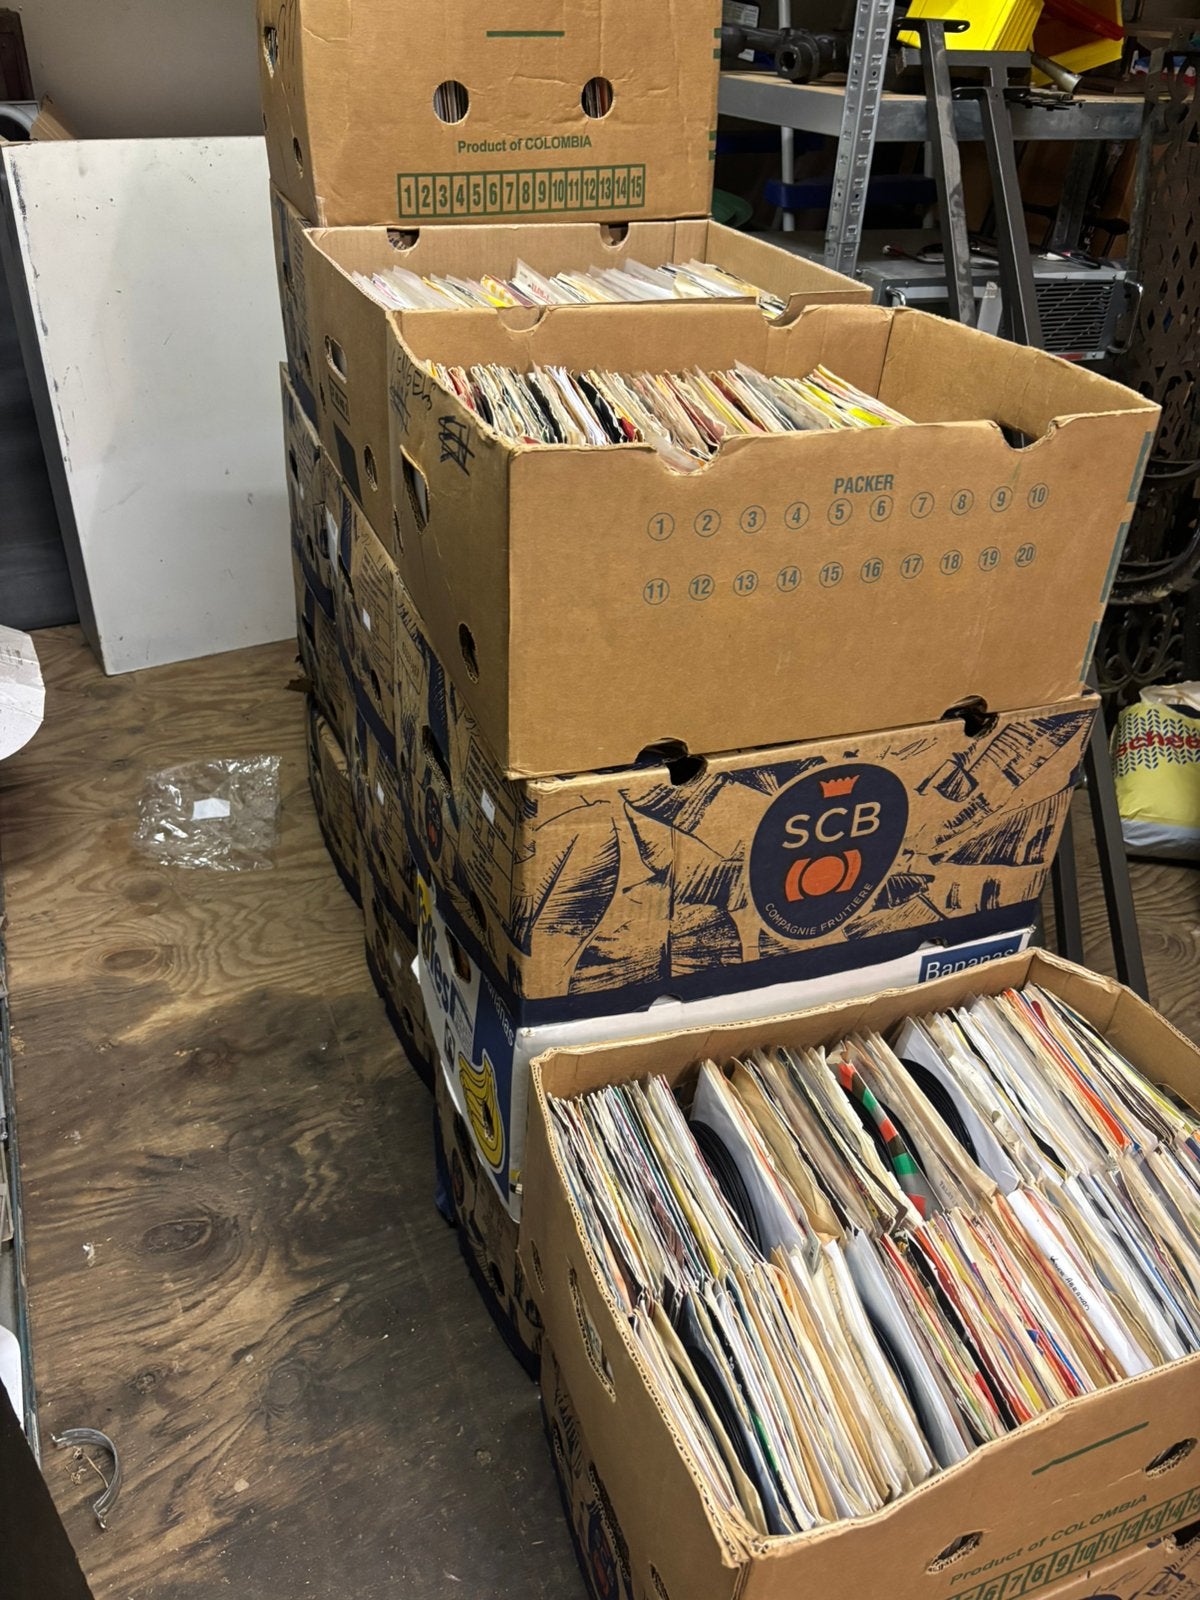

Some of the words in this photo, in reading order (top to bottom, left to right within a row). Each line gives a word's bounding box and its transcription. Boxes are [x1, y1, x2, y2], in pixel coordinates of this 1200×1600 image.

[457, 139, 507, 154] Product
[510, 137, 524, 151] of
[524, 135, 592, 150] COLOMBIA
[404, 184, 412, 208] 1
[421, 184, 430, 208] 2
[438, 184, 448, 208] 3
[456, 184, 464, 207] 4
[472, 183, 481, 207] 5
[488, 182, 498, 206] 6
[505, 181, 514, 205] 7
[522, 180, 530, 204] 8
[538, 180, 546, 203] 9
[552, 178, 564, 203] 10
[568, 178, 580, 202] 11
[584, 177, 596, 201] 12
[600, 176, 612, 200] 13
[615, 175, 626, 199] 14
[631, 174, 642, 198] 15
[833, 473, 895, 495] PACKER
[656, 519, 665, 535] 1
[702, 515, 712, 532] 2
[748, 511, 758, 528] 3
[791, 507, 801, 524] 4
[835, 504, 845, 520] 5
[876, 500, 886, 517] 6
[918, 497, 928, 514] 7
[957, 494, 967, 510] 8
[996, 491, 1006, 508] 9
[1030, 488, 1046, 504] 10
[648, 583, 664, 600] 11
[693, 578, 710, 596] 12
[738, 574, 755, 591] 13
[781, 570, 798, 587] 14
[823, 566, 840, 583] 15
[864, 562, 881, 578] 16
[904, 558, 921, 574] 17
[944, 554, 960, 570] 18
[982, 550, 998, 566] 19
[1018, 548, 1034, 563] 20
[782, 801, 881, 849] SCB
[764, 902, 817, 936] COMPAGNIE
[950, 1547, 1024, 1585] Product
[1027, 1536, 1047, 1551] of
[1050, 1494, 1148, 1541] COLOMBIA
[985, 1584, 999, 1600] 6
[1011, 1575, 1025, 1594] 7
[1031, 1566, 1047, 1584] 8
[1055, 1556, 1067, 1574] 9
[1077, 1544, 1096, 1564] 10
[1101, 1534, 1117, 1554] 11
[1122, 1523, 1139, 1543] 12
[1144, 1511, 1161, 1532] 13
[1166, 1500, 1184, 1521] 14
